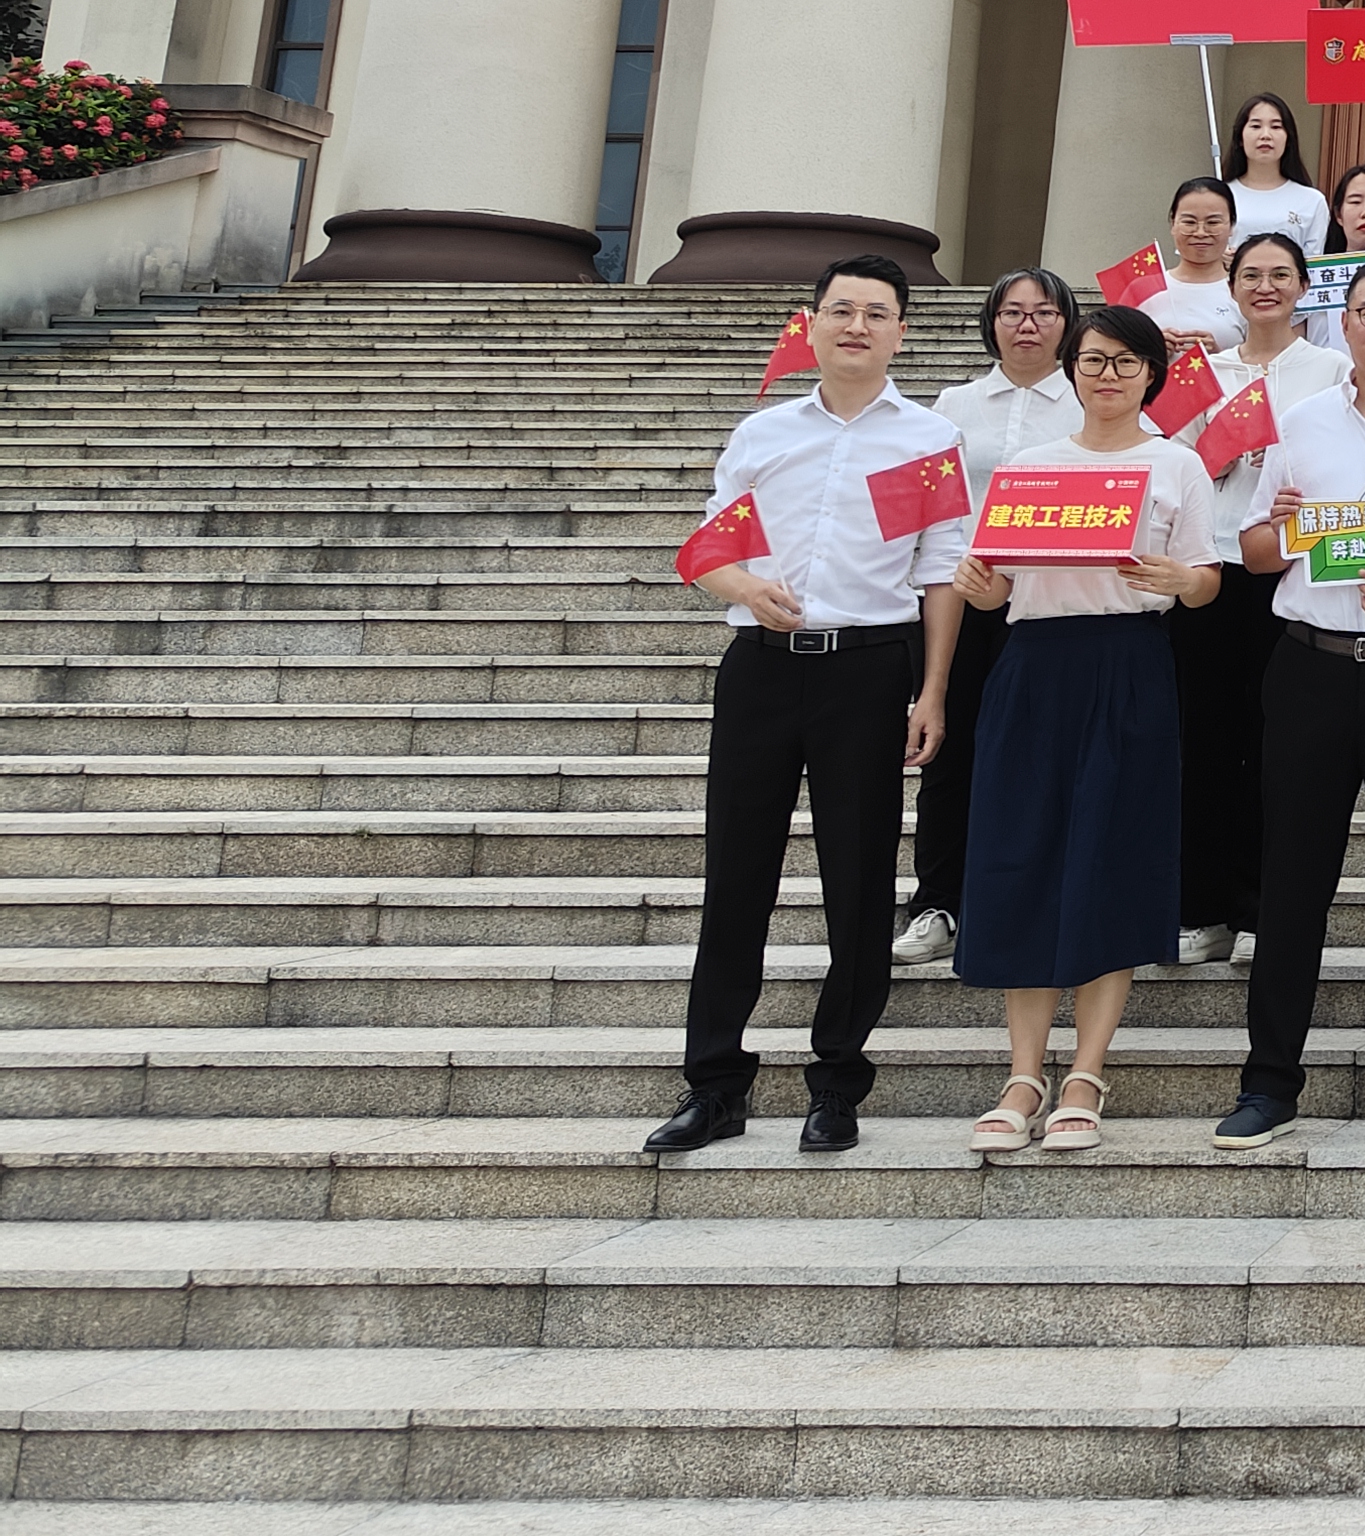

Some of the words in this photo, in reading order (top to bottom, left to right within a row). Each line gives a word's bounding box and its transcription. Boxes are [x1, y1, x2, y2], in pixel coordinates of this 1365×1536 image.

[985, 504, 1133, 529] 建筑工程技术
